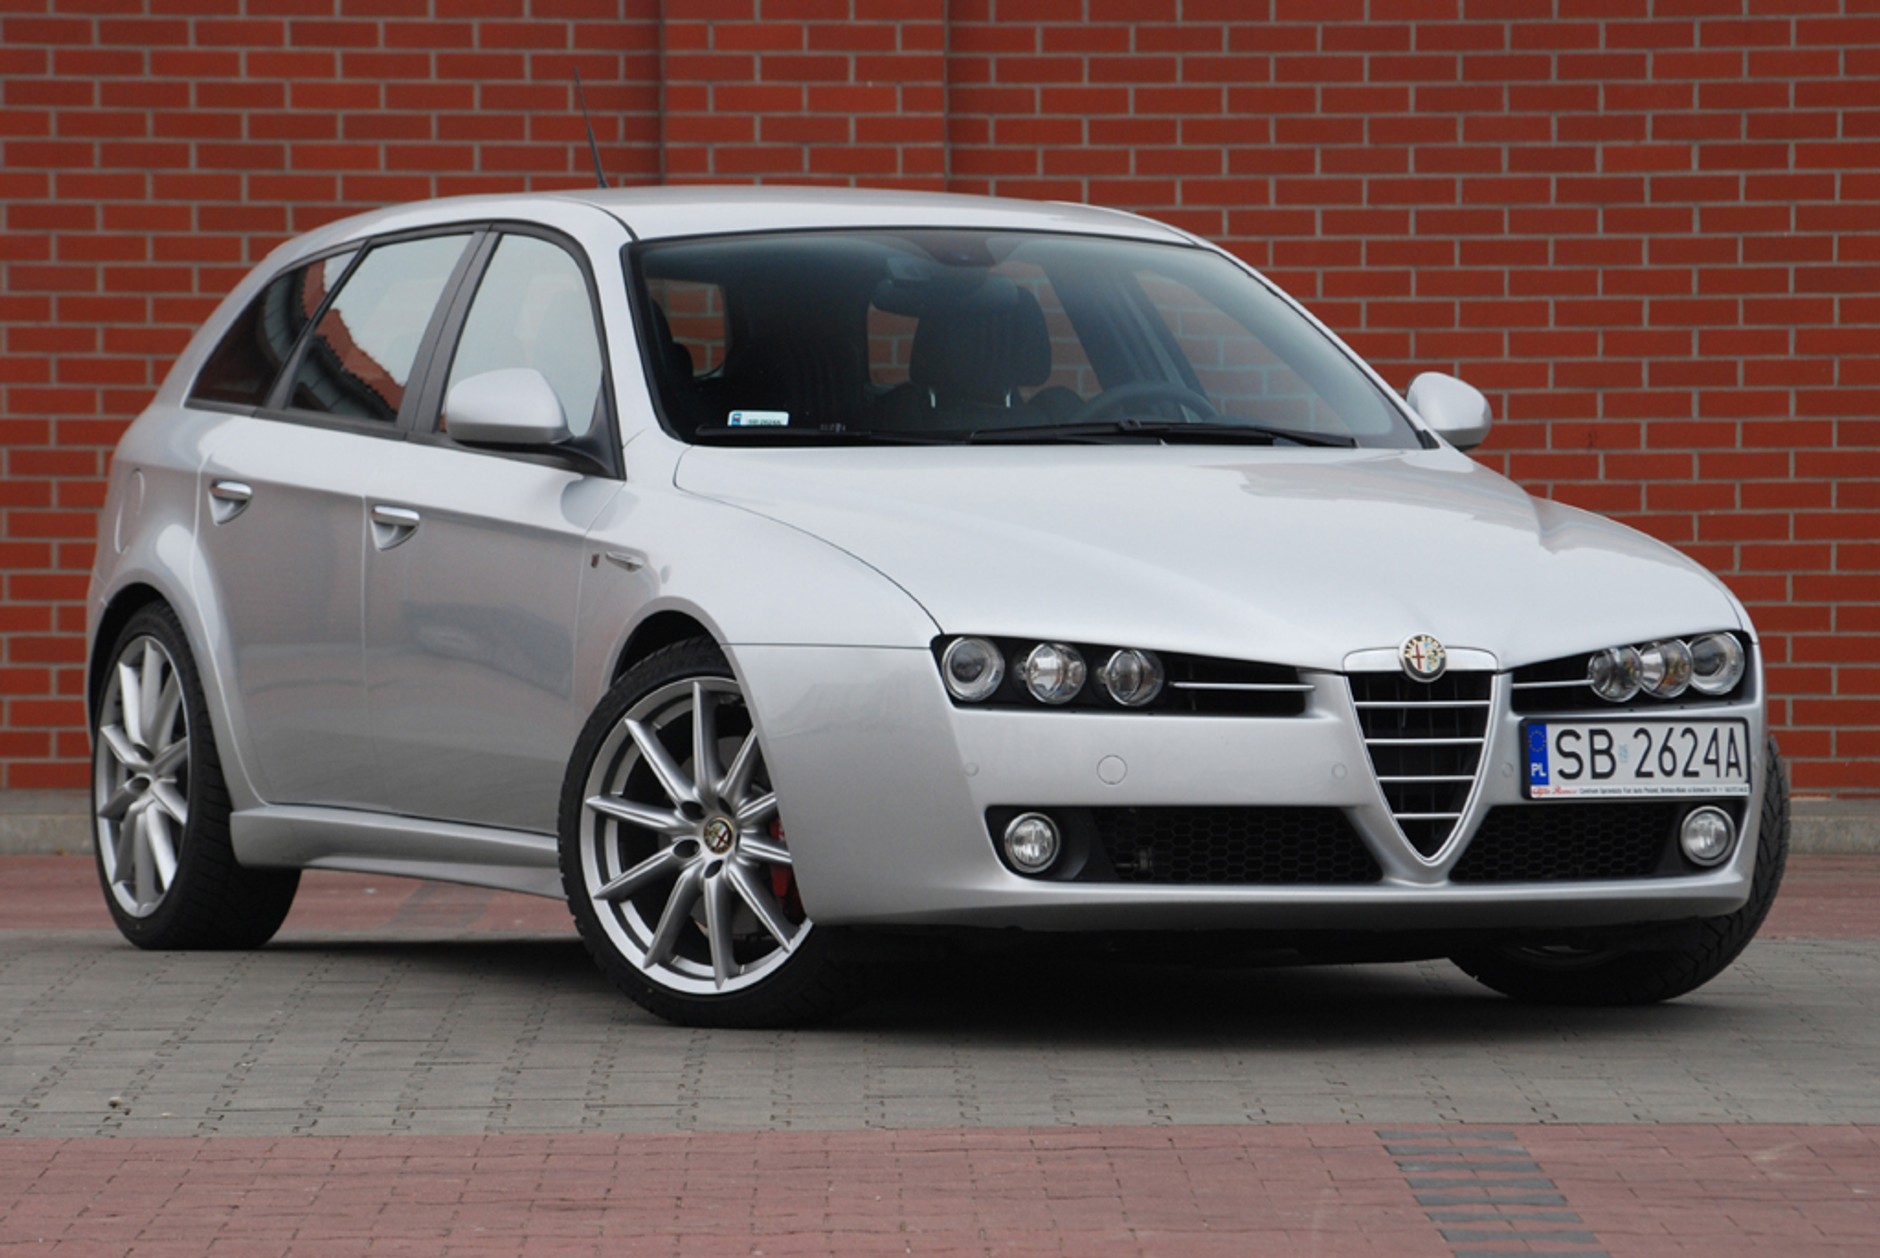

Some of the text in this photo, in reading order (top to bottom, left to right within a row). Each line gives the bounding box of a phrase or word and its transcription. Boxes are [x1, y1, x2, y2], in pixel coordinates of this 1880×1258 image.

[1531, 763, 1546, 777] PL
[1555, 727, 1742, 780] SB 2624A
